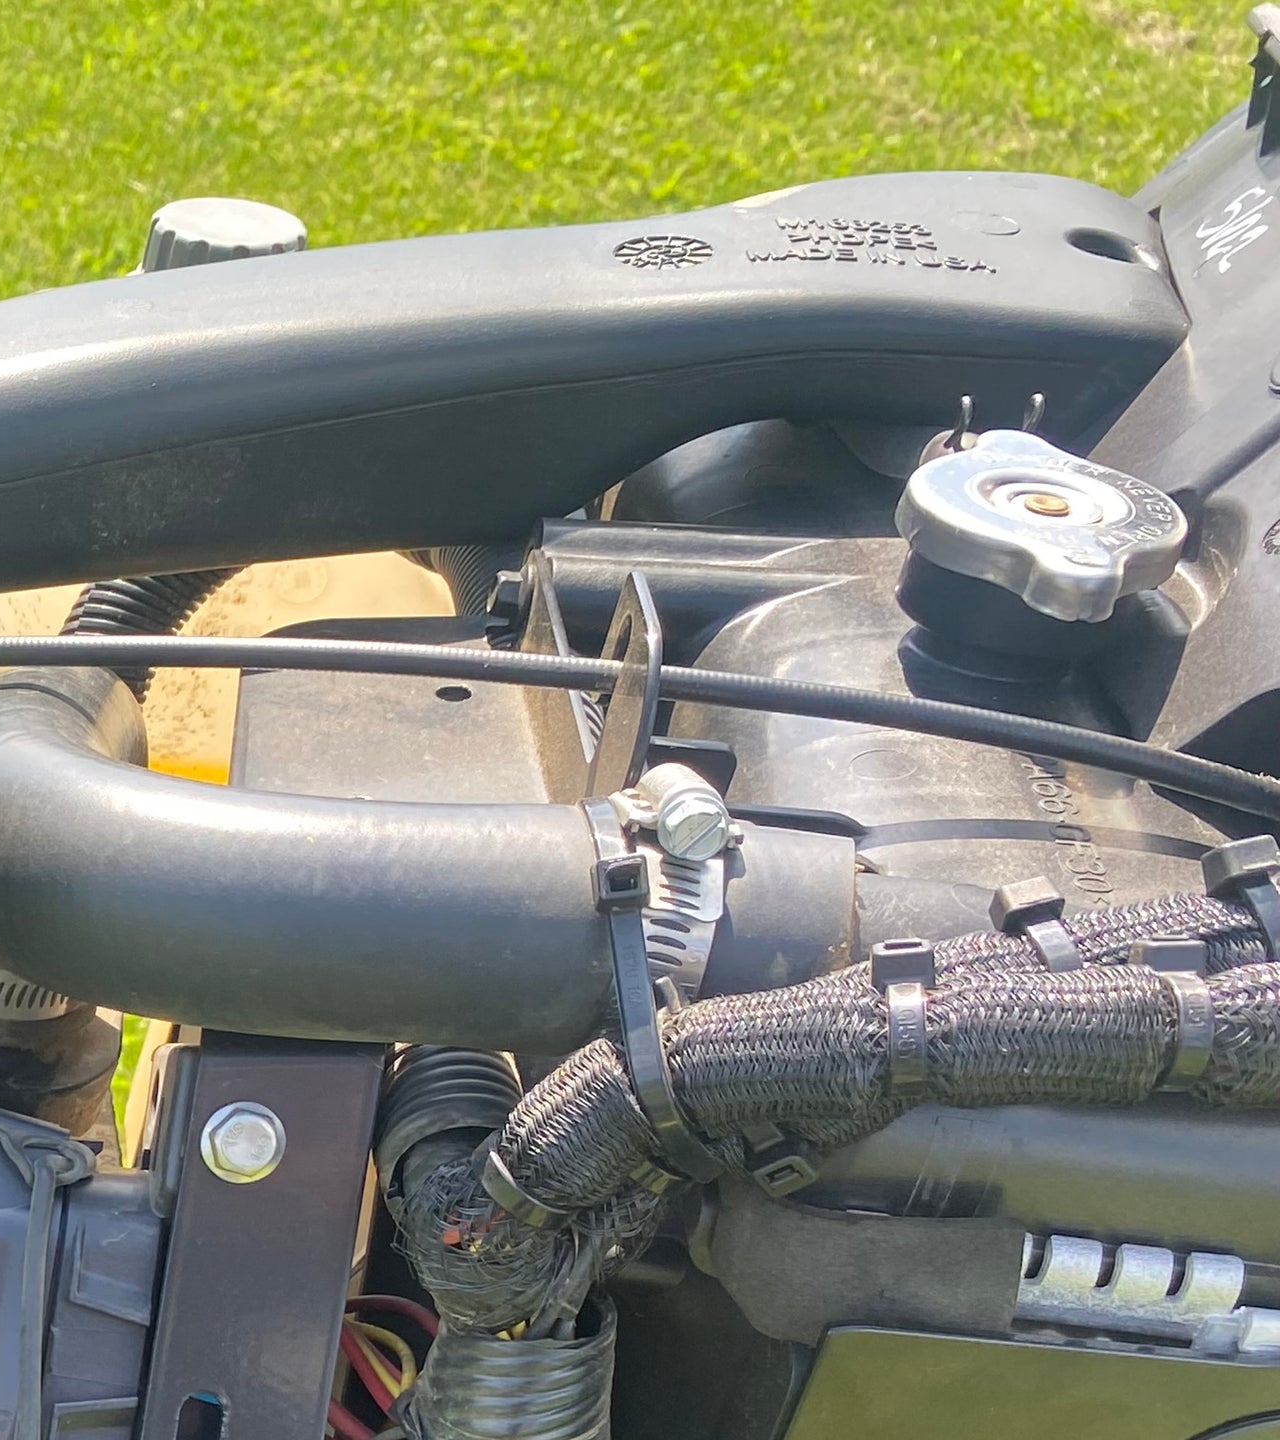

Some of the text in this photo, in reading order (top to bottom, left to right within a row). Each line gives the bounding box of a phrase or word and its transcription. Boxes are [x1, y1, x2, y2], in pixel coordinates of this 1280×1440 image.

[745, 248, 997, 274] MADE IN USA
